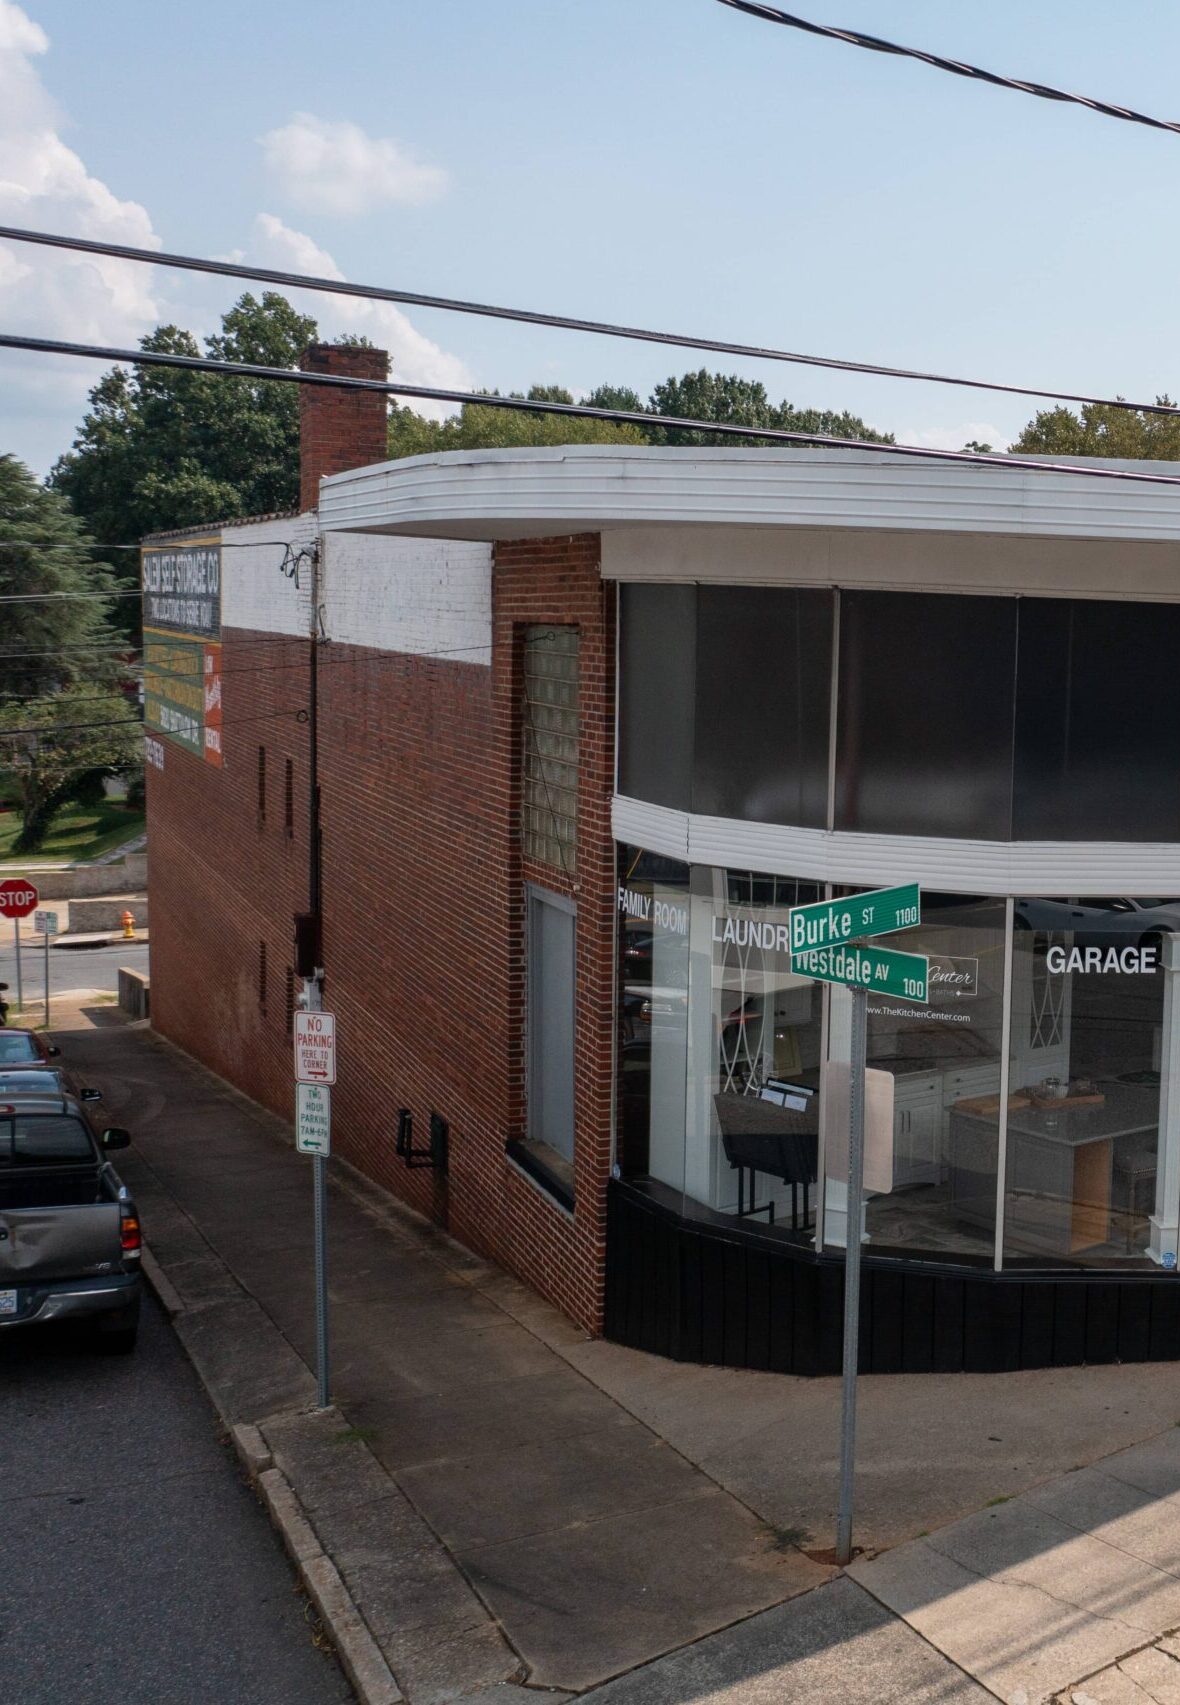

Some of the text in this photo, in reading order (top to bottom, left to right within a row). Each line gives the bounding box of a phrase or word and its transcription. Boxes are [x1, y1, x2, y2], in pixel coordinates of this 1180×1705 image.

[0, 891, 35, 907] STOP
[618, 886, 687, 936] FAMILY ROOM
[712, 915, 791, 953] LAUNDR
[793, 906, 918, 949] Burke ST 1100
[1046, 946, 1157, 975] GARAGE
[874, 963, 890, 981] AV
[903, 978, 924, 998] 100
[928, 965, 973, 985] Center
[865, 1006, 971, 1022] ww.TheKitchenCenter.com
[307, 1018, 322, 1032] NO
[298, 1033, 333, 1049] PARKING
[301, 1049, 329, 1060] HERE TO
[303, 1059, 328, 1070] CORNER
[305, 1101, 324, 1112] HOUR
[300, 1113, 328, 1126] PARKING
